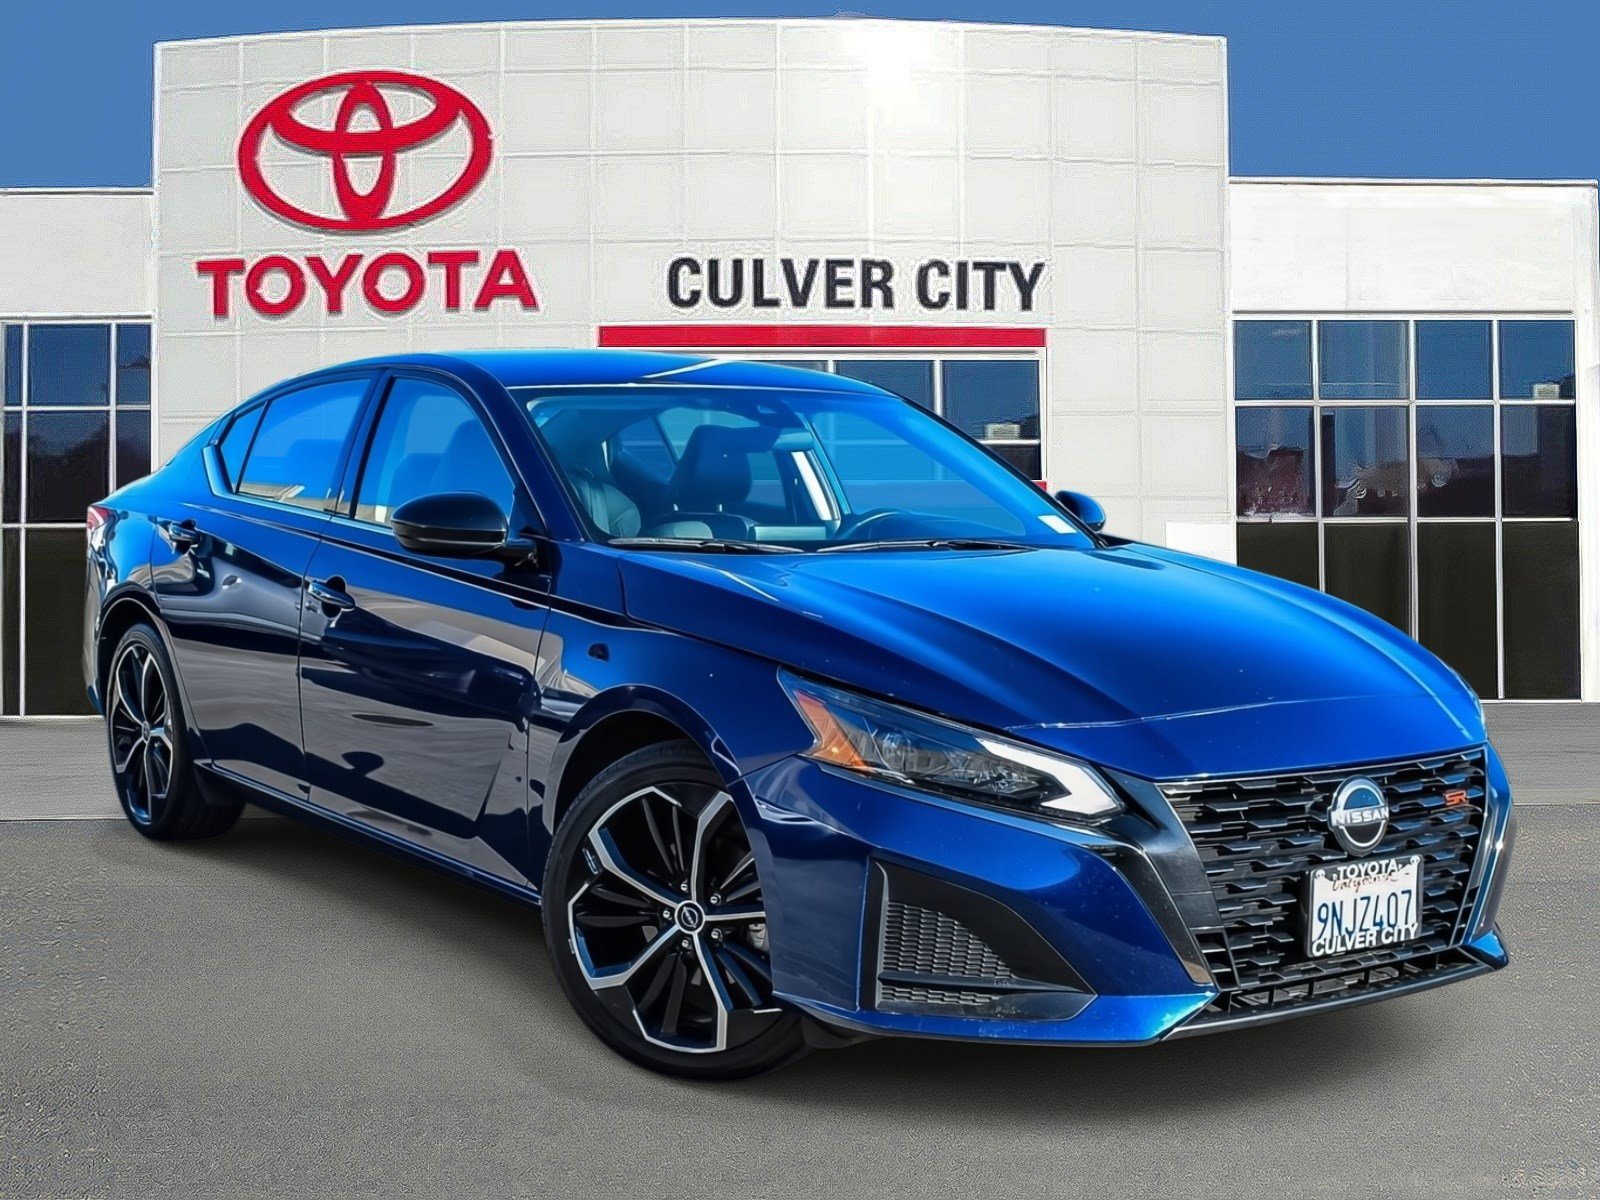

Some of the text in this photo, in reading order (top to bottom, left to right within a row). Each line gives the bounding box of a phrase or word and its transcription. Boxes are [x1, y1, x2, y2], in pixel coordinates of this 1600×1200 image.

[196, 249, 538, 319] TOYOTA
[667, 257, 1046, 311] CULVER CITY
[1445, 790, 1467, 806] SR
[1332, 806, 1389, 825] NISSAN
[1337, 859, 1398, 880] TOYOTA
[1317, 889, 1412, 941] 9NJZ407
[1312, 922, 1419, 956] CULVER CITY
